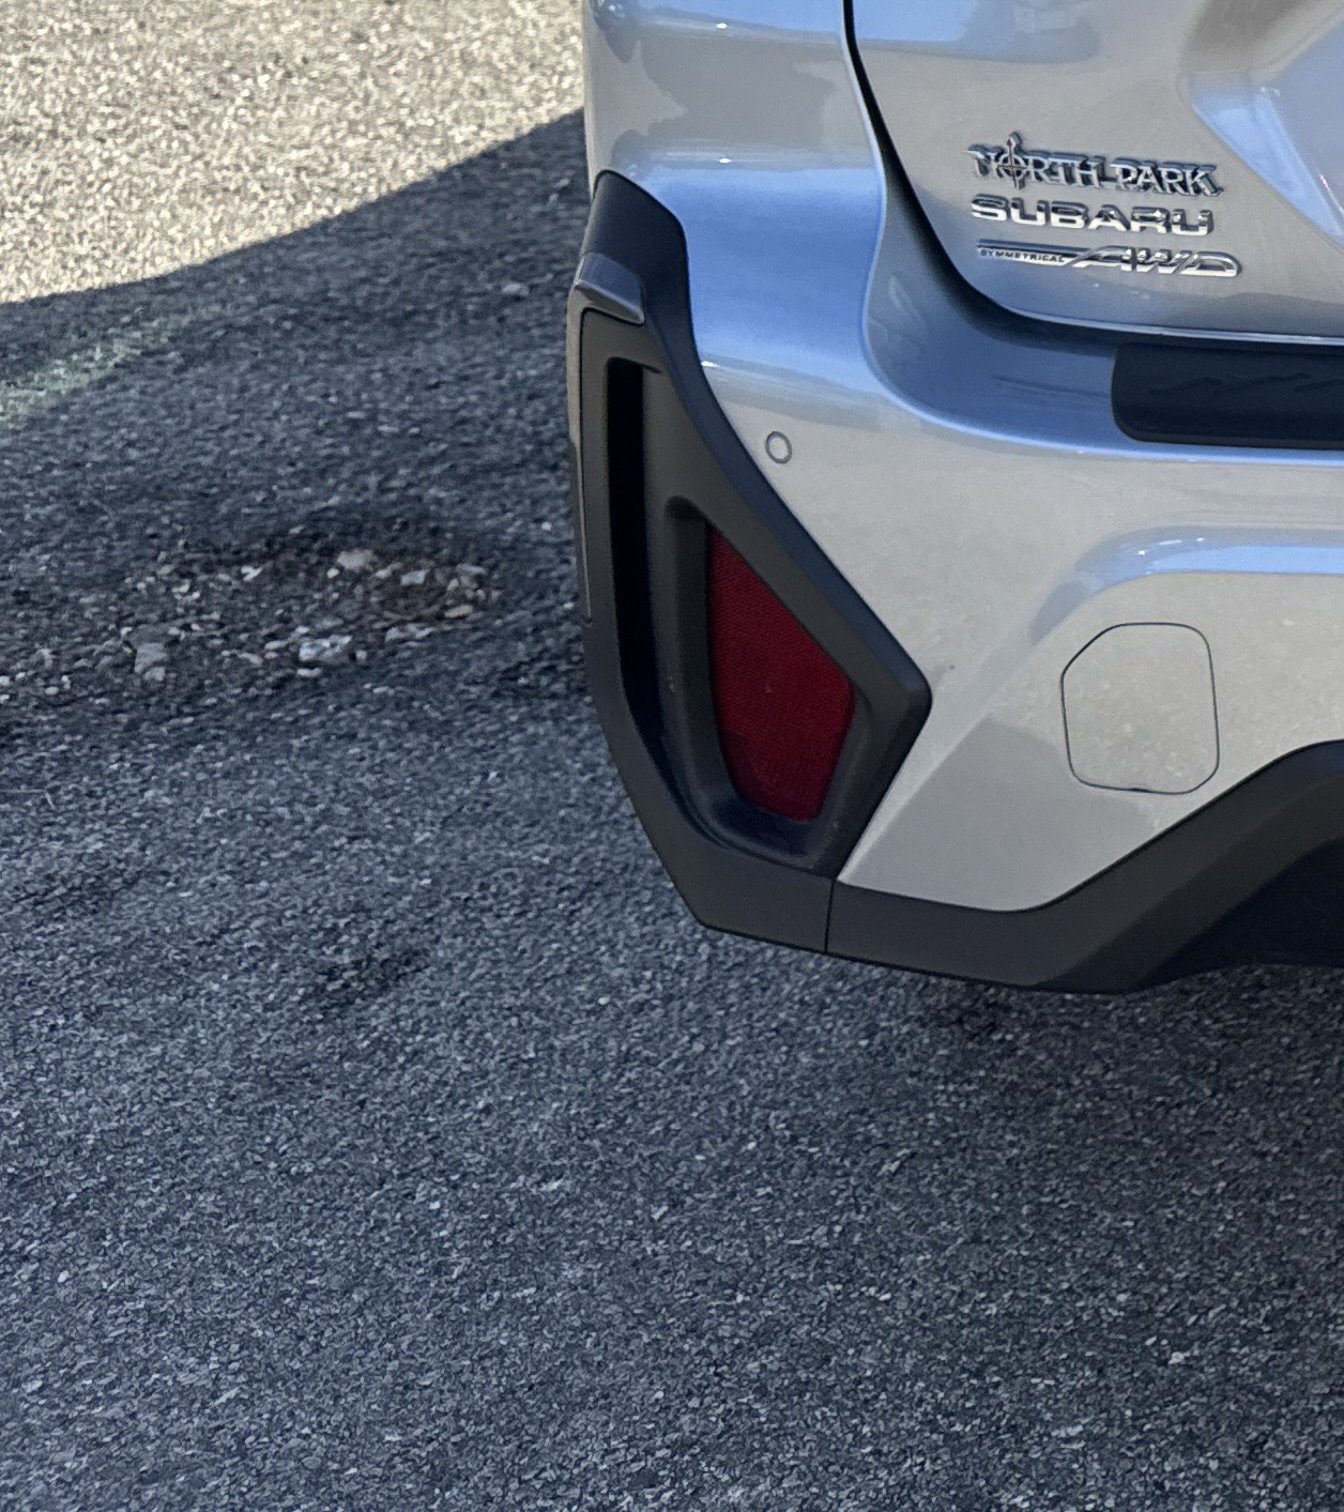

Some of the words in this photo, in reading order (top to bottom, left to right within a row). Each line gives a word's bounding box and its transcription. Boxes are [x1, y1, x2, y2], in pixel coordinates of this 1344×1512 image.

[966, 131, 1106, 189] NORTH
[1109, 157, 1223, 197] PARK
[971, 193, 1213, 237] SUBARU
[979, 248, 1066, 263] SYMMETRICAL
[1072, 244, 1241, 278] AWD
